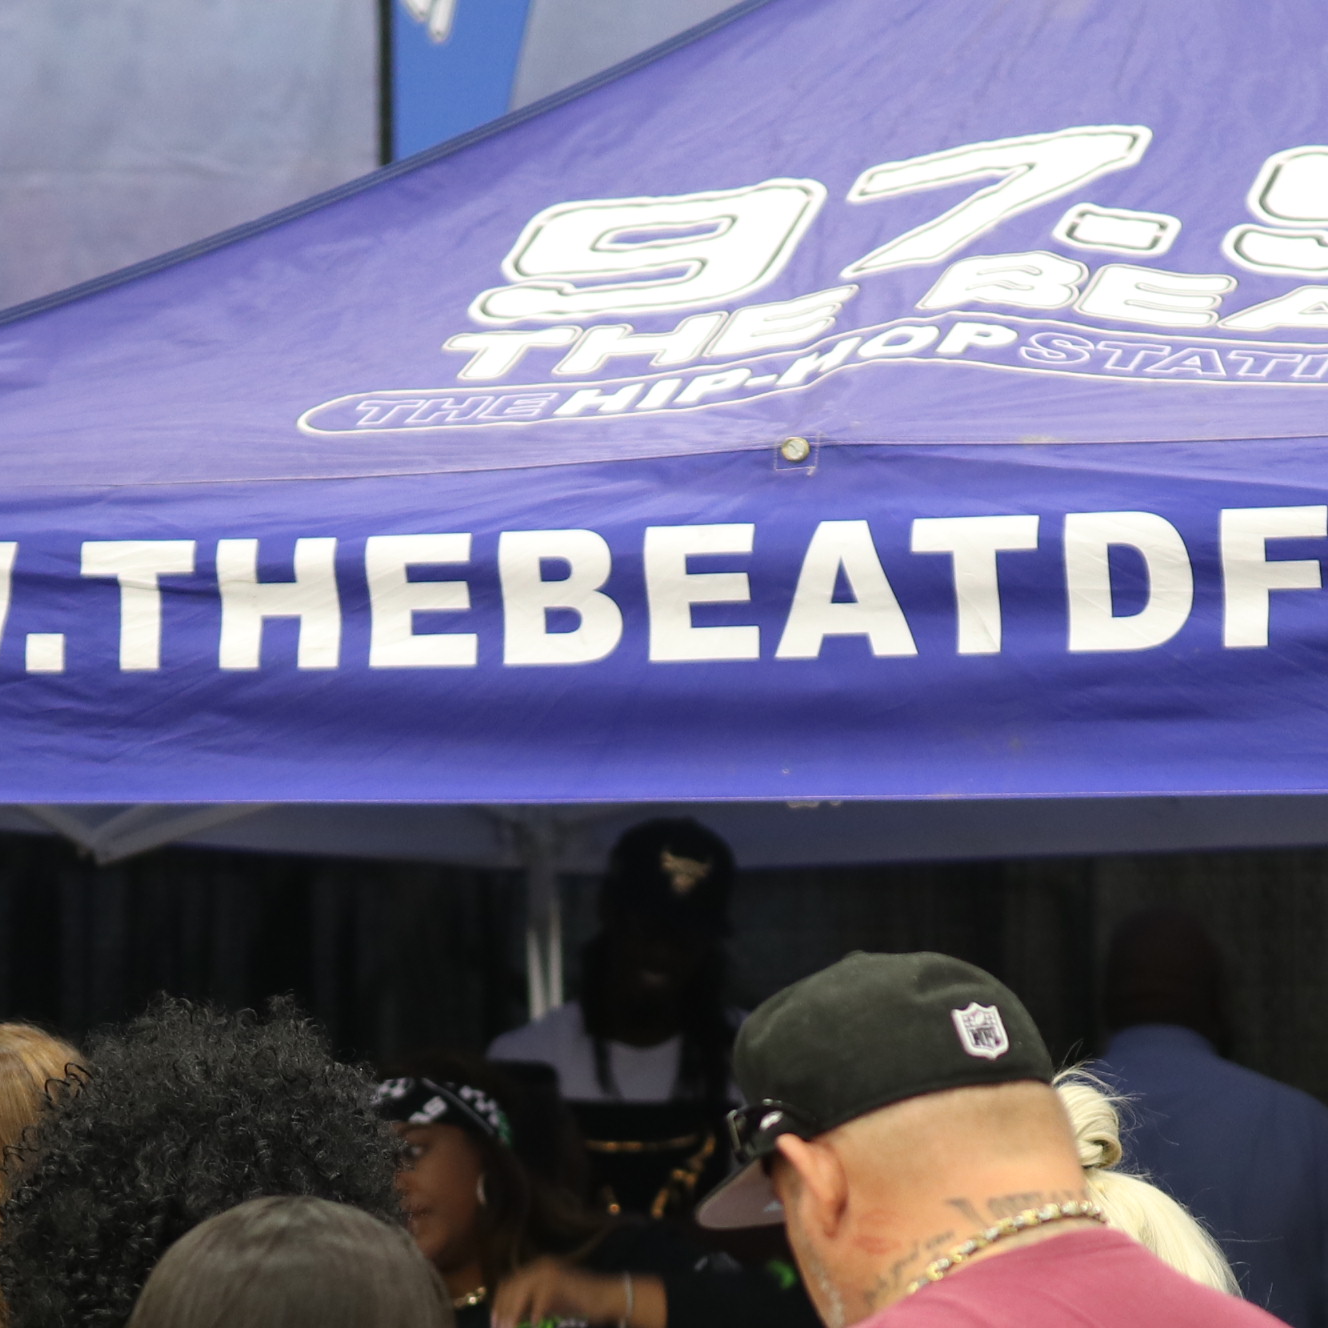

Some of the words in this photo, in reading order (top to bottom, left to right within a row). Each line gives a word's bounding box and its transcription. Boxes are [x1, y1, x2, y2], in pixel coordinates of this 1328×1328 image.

[352, 391, 558, 426] THE
[552, 320, 1018, 417] HIP-HOP
[442, 284, 860, 381] THE
